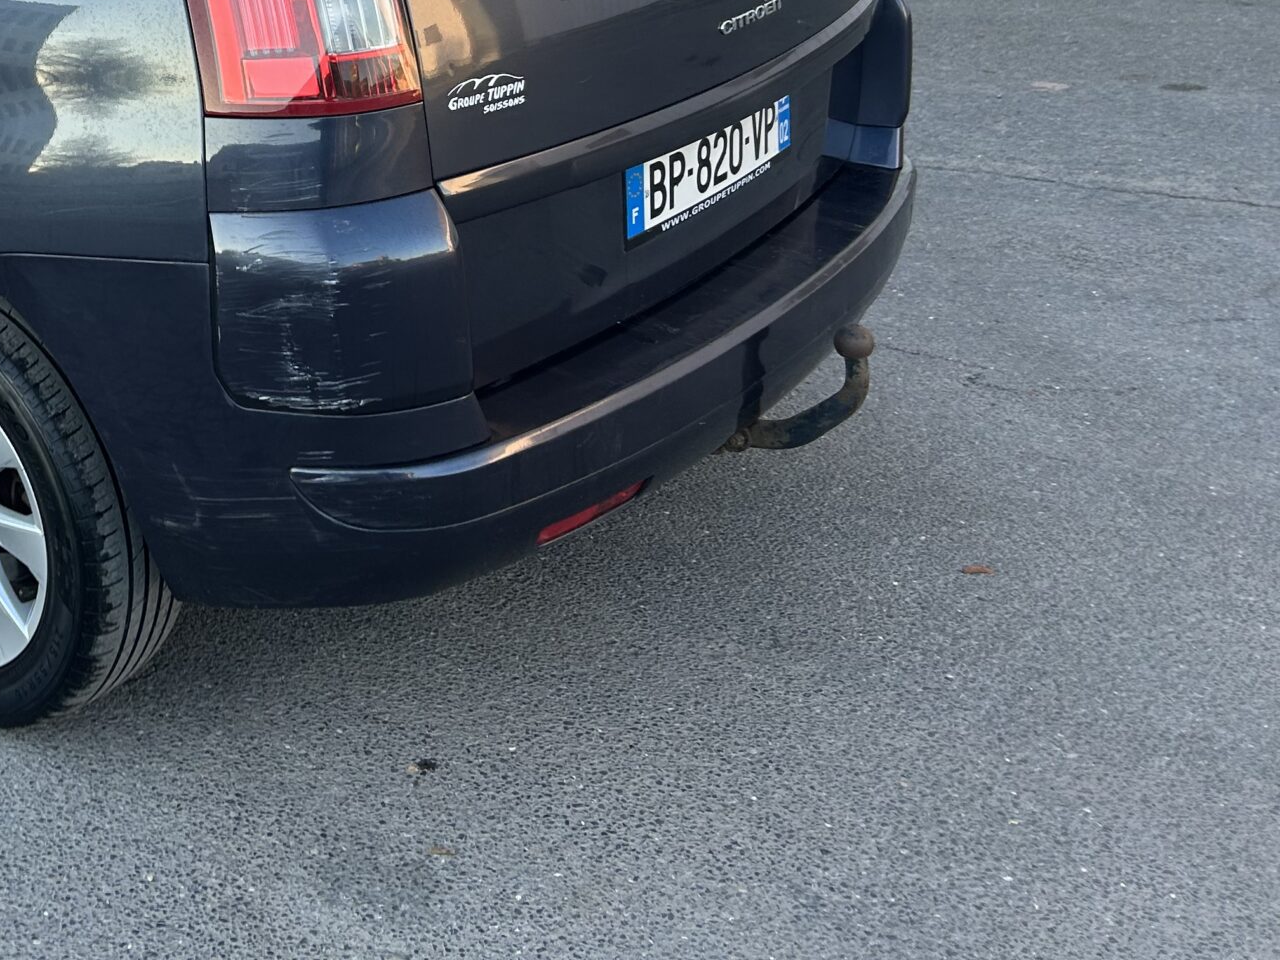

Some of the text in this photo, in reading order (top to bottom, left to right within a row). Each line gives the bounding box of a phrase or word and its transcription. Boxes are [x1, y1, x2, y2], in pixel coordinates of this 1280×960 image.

[448, 80, 525, 111] GROUPE TUPPIN
[779, 119, 789, 144] 02
[649, 102, 776, 220] BP-820-VP
[661, 161, 770, 231] WWW.GROUPETUPPIN.COM
[632, 207, 639, 224] F
